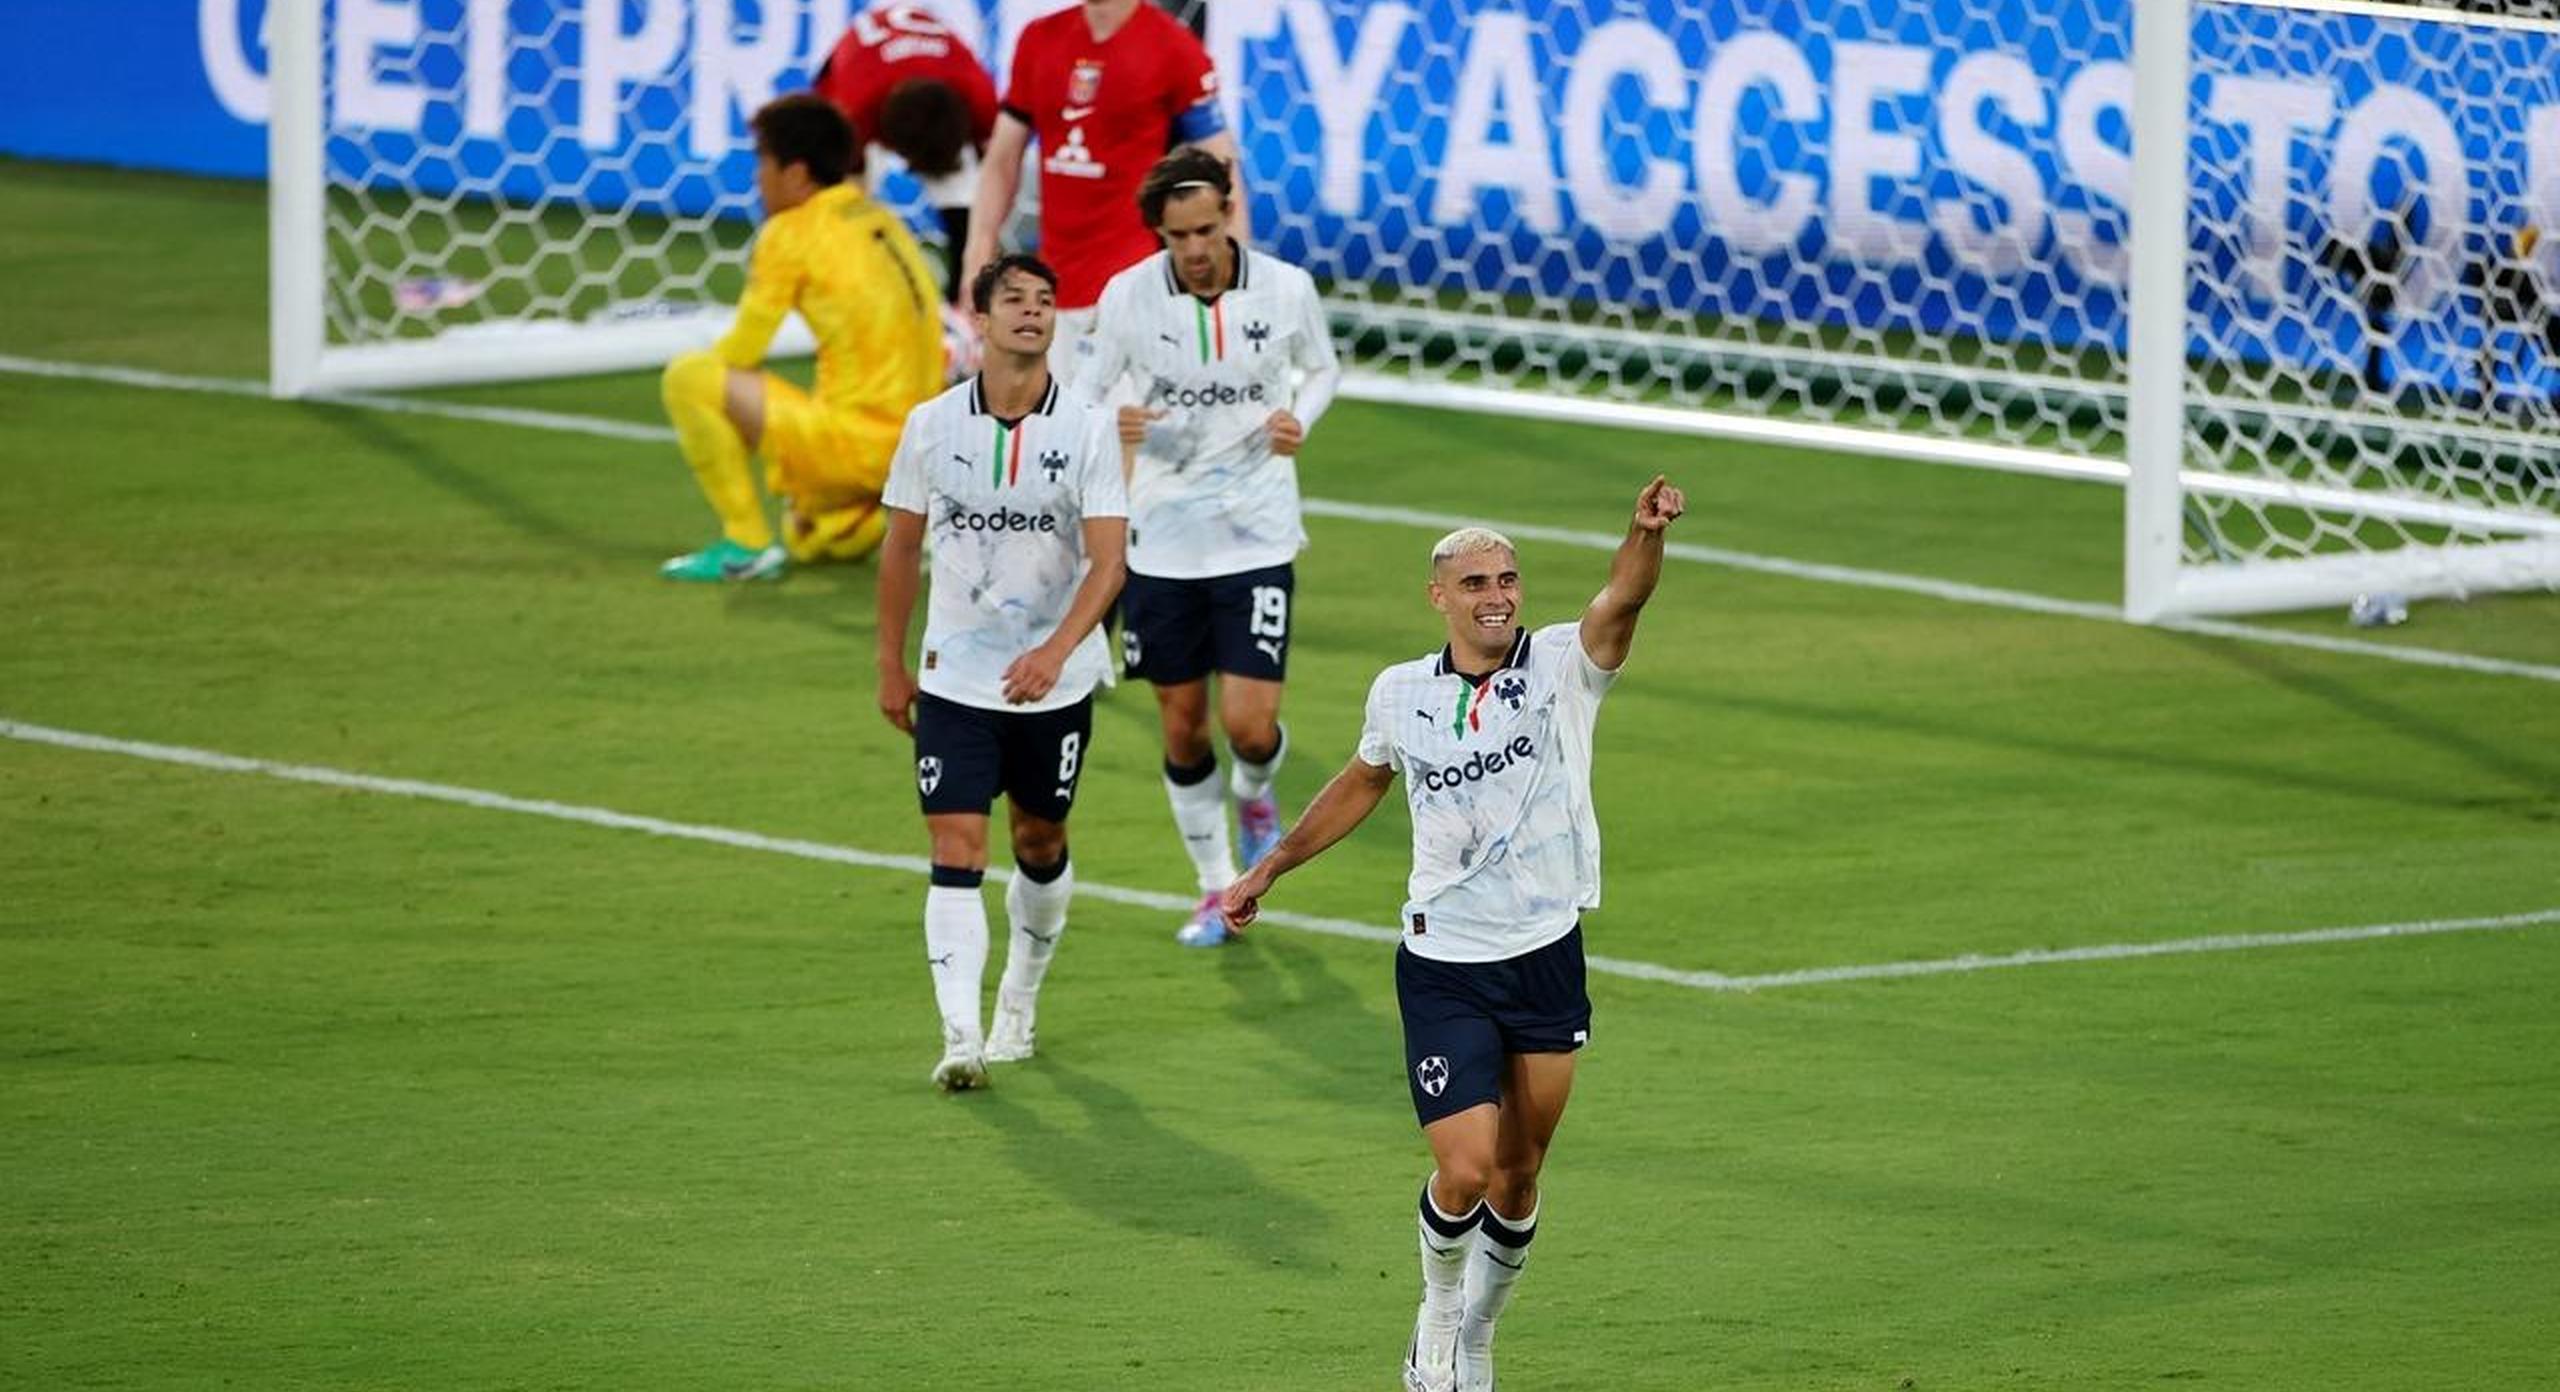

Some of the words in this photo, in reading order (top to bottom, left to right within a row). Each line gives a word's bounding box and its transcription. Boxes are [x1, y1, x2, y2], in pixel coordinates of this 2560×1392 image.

[1432, 12, 2134, 284] ACCESS
[2209, 76, 2467, 314] TO
[1163, 382, 1264, 407] codere
[951, 506, 1056, 531] codere
[1250, 586, 1287, 637] 19
[1059, 731, 1080, 782] 8
[1425, 735, 1534, 791] codere
